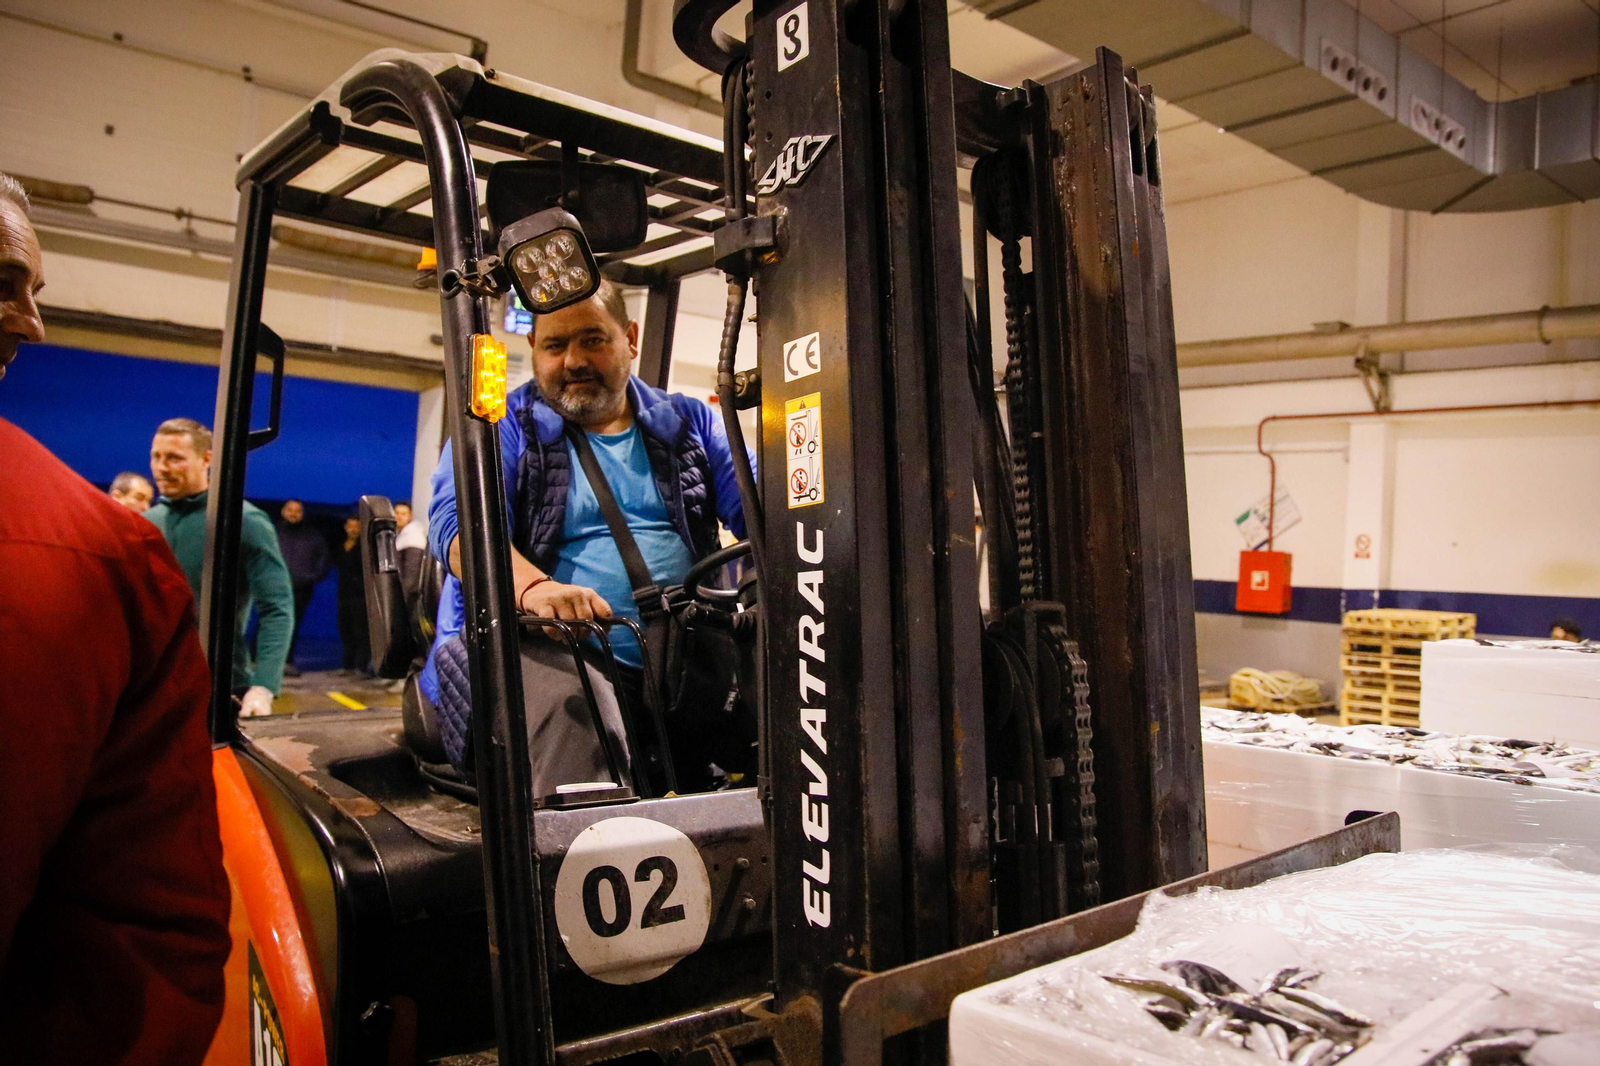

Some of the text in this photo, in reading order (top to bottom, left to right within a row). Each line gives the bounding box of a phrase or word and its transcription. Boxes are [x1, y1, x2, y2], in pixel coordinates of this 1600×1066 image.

[786, 336, 818, 376] CE
[796, 521, 831, 929] ELEVATRAC
[582, 856, 686, 938] 02
